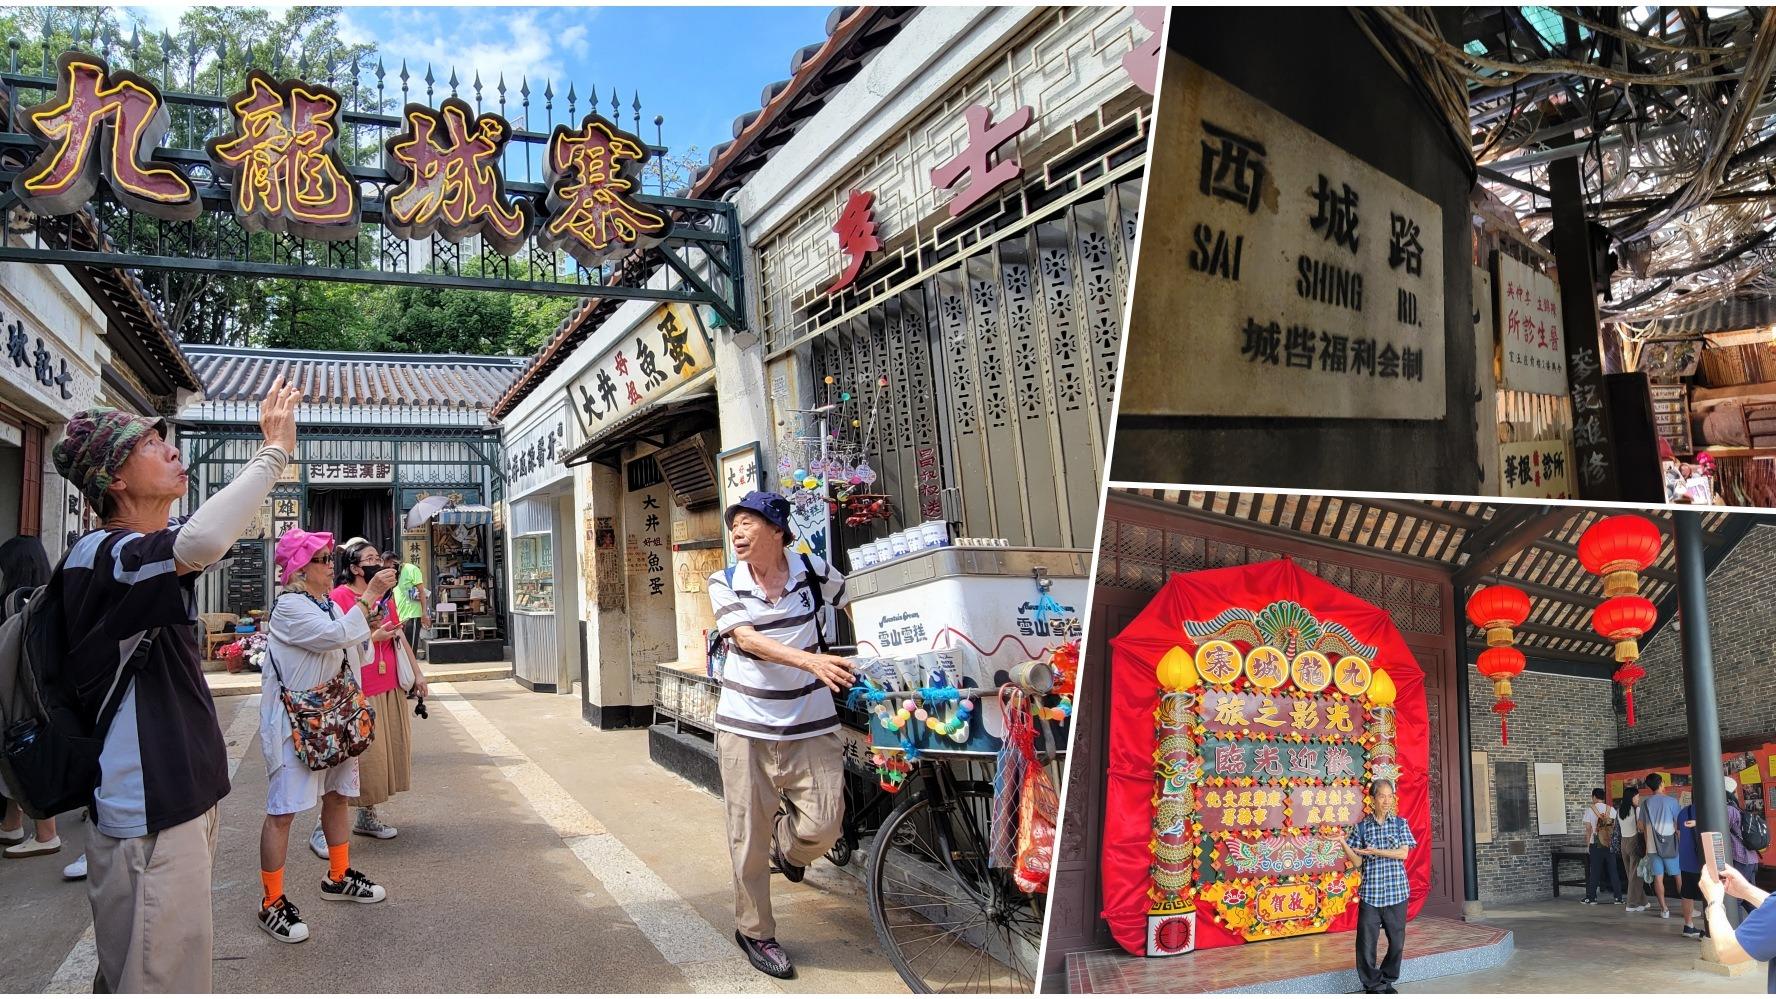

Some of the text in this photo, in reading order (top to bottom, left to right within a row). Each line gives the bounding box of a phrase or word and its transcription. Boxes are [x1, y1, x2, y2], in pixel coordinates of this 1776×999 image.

[14, 53, 670, 262] 九龍城寨
[1199, 119, 1424, 278] 西城路
[1189, 222, 1422, 328] SAI SHING RD.
[0, 311, 73, 400] 七記冰
[879, 622, 927, 648] 雪山雪糕
[1204, 645, 1366, 690] 九龍城寨
[1213, 695, 1355, 732] 光影之旅
[1214, 741, 1356, 777] 歡迎光臨
